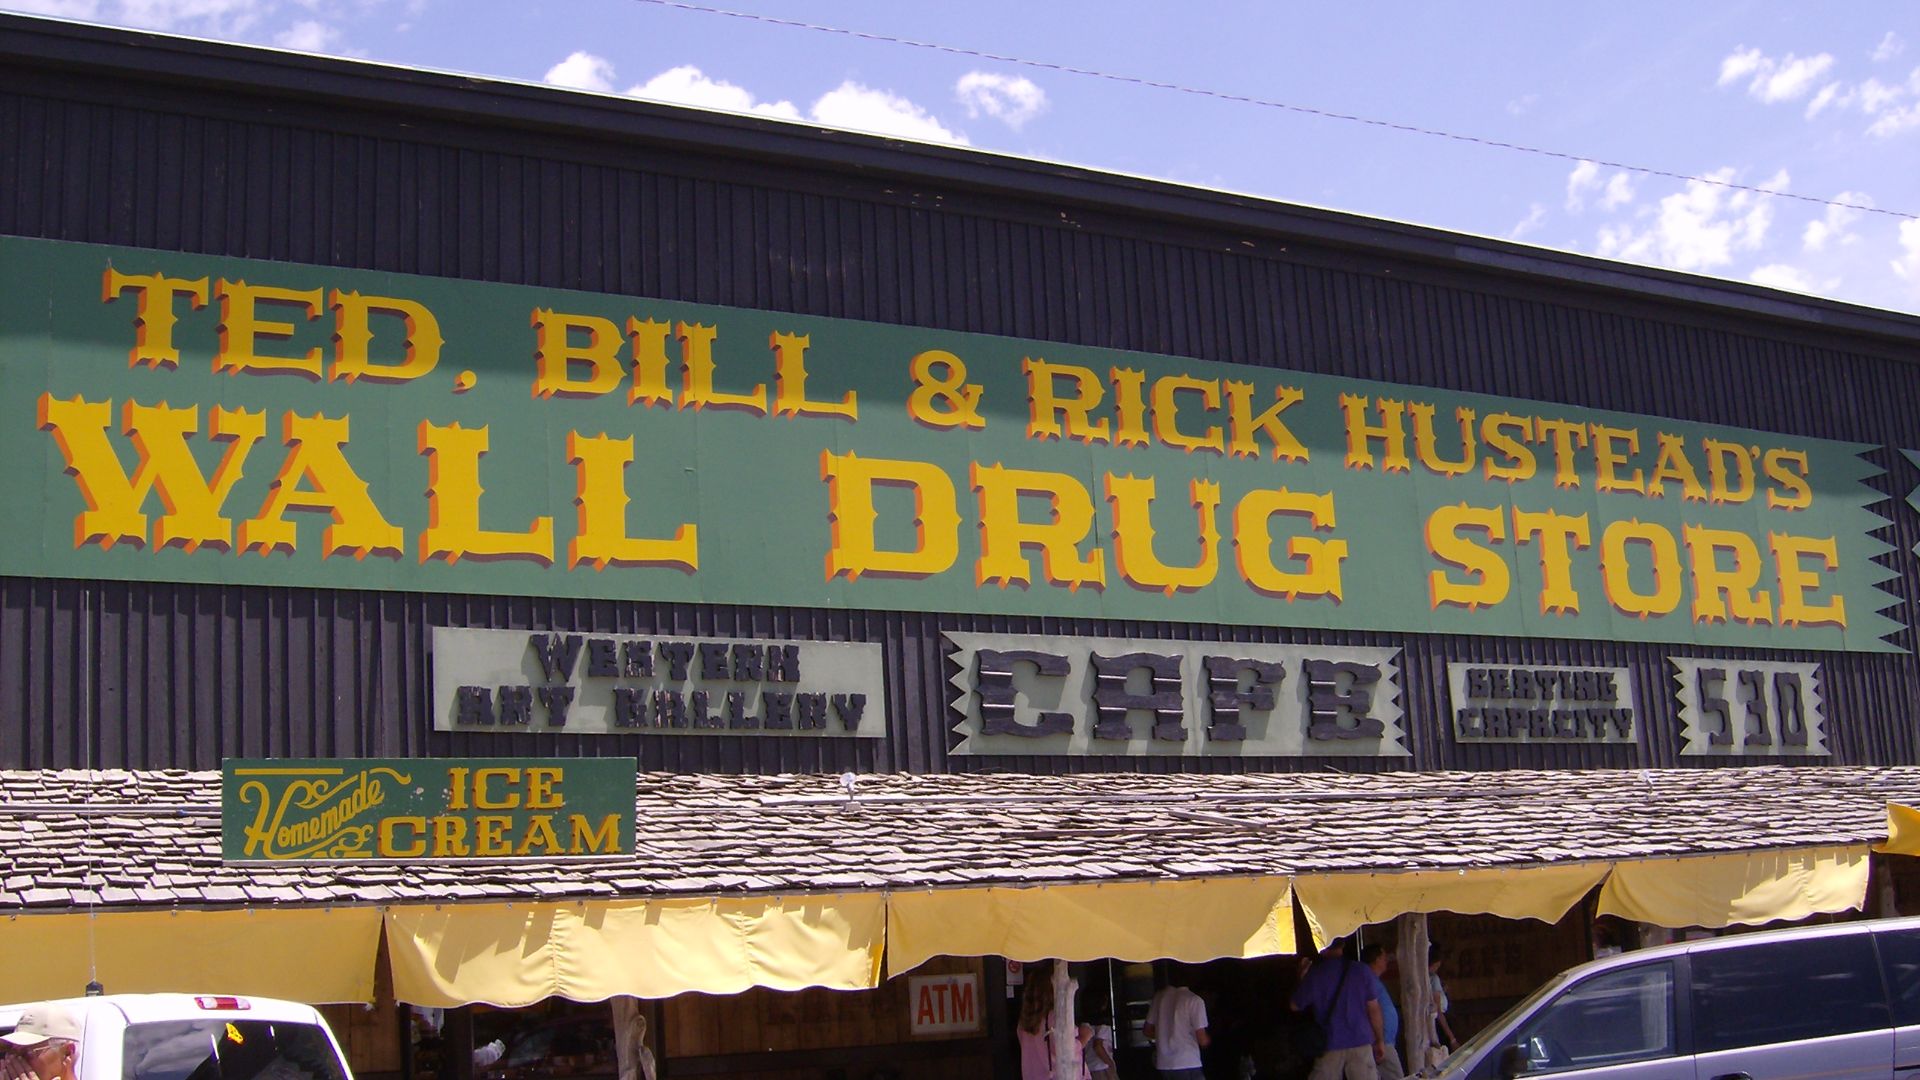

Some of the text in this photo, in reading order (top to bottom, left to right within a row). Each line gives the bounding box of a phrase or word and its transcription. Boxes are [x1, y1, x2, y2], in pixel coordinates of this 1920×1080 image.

[532, 307, 857, 421] BILL
[907, 349, 986, 431] &
[1022, 356, 1310, 463] RICK
[1339, 392, 1812, 512] HUSTEAD'S
[37, 391, 1847, 630] WALL DRUG STORE
[529, 633, 800, 682] WESTERN
[457, 685, 867, 731] ART GALLERY
[975, 649, 1384, 742] CAFE
[1466, 668, 1618, 701] SEATING
[1697, 667, 1808, 746] 530
[1457, 708, 1633, 738] CAPACITY
[448, 767, 566, 811] ICE
[239, 770, 385, 860] Homemade
[377, 814, 622, 857] CREAM
[917, 983, 974, 1025] ATM
